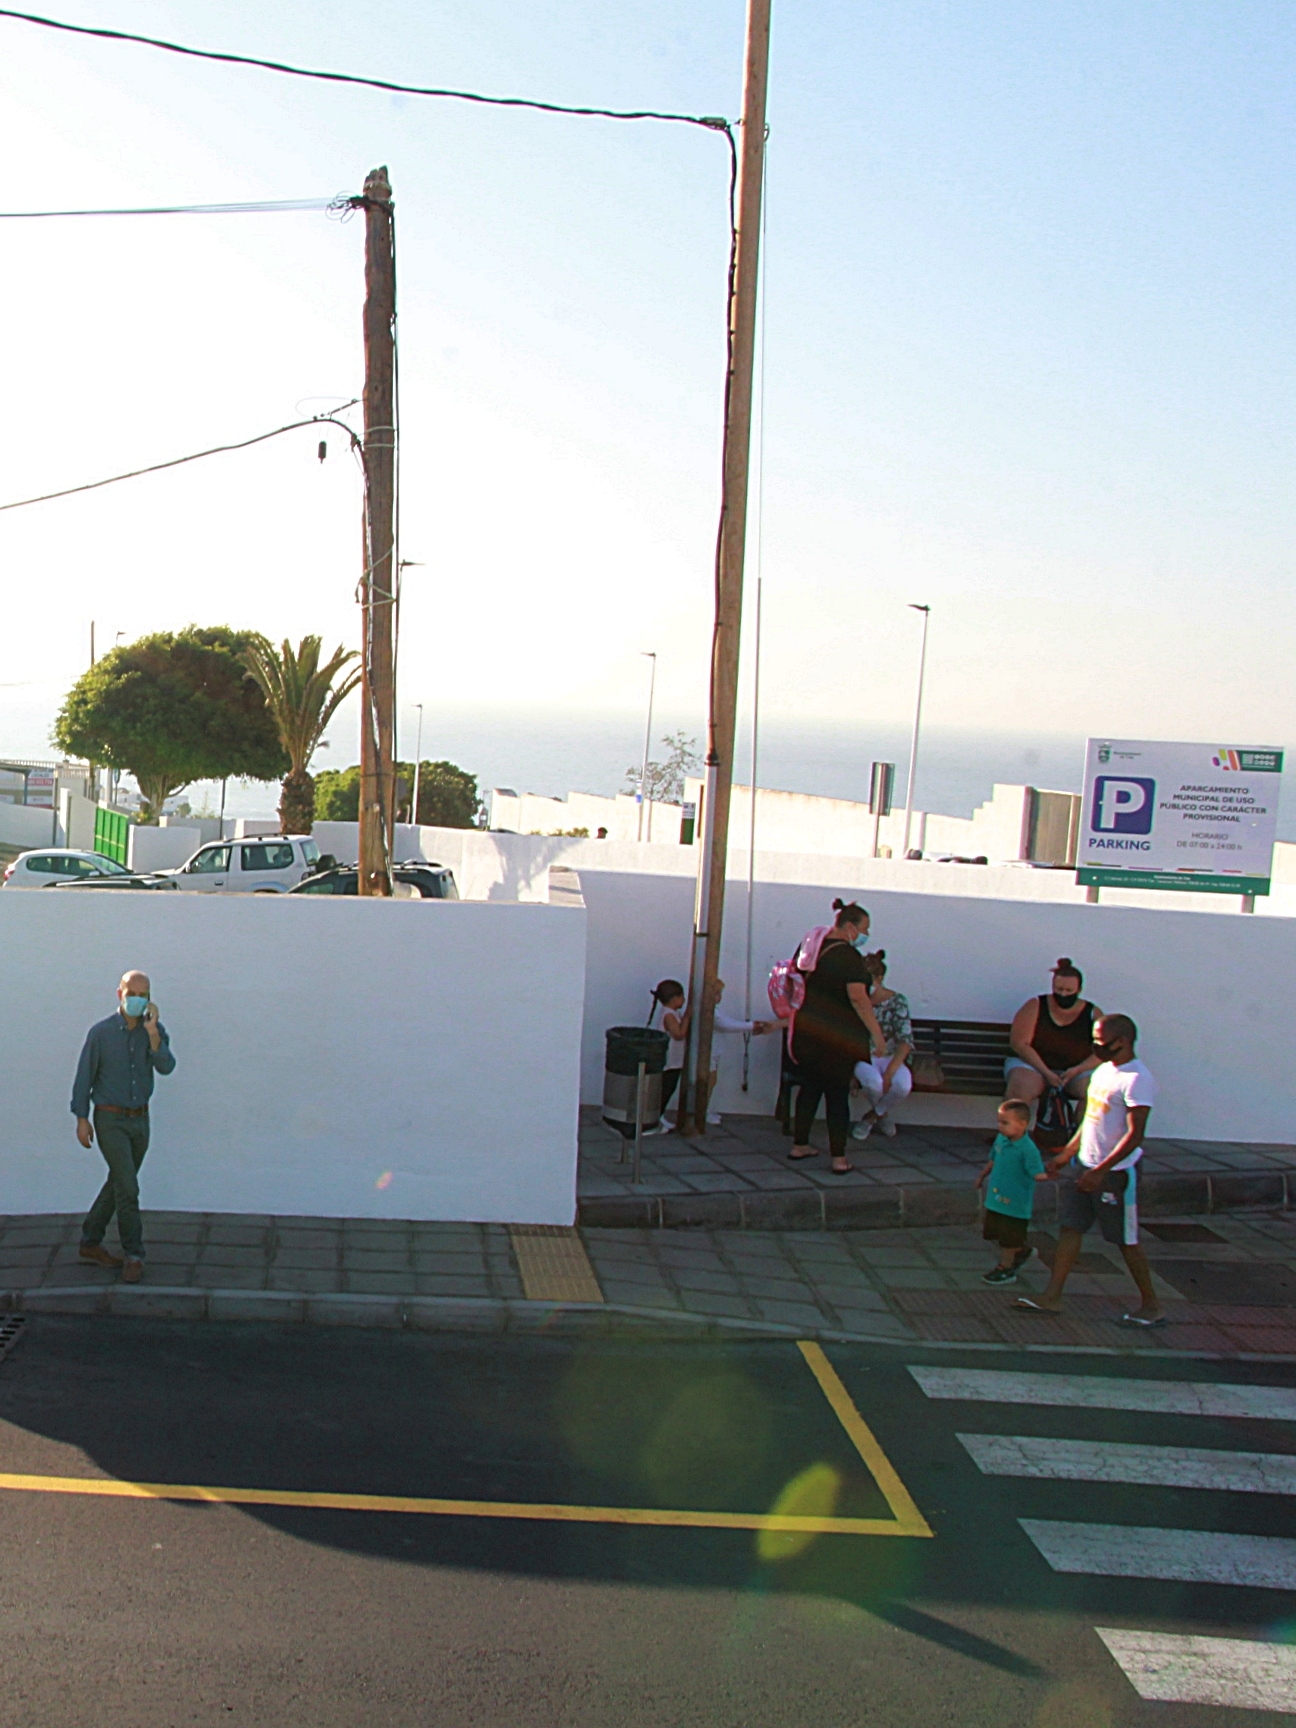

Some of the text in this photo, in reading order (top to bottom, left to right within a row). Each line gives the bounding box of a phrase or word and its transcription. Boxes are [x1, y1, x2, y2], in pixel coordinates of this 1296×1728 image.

[1180, 785, 1249, 795] APARCAMIENTO
[1100, 780, 1146, 829] P
[1173, 794, 1255, 805] MUNICIPAL DE USO
[1160, 801, 1267, 815] PÚBLICO CON CARÁCTER
[1183, 813, 1241, 823] PROVISIONAL
[1192, 832, 1229, 840] HORARIO
[1088, 838, 1151, 851] PARKING
[1176, 840, 1188, 848] DE
